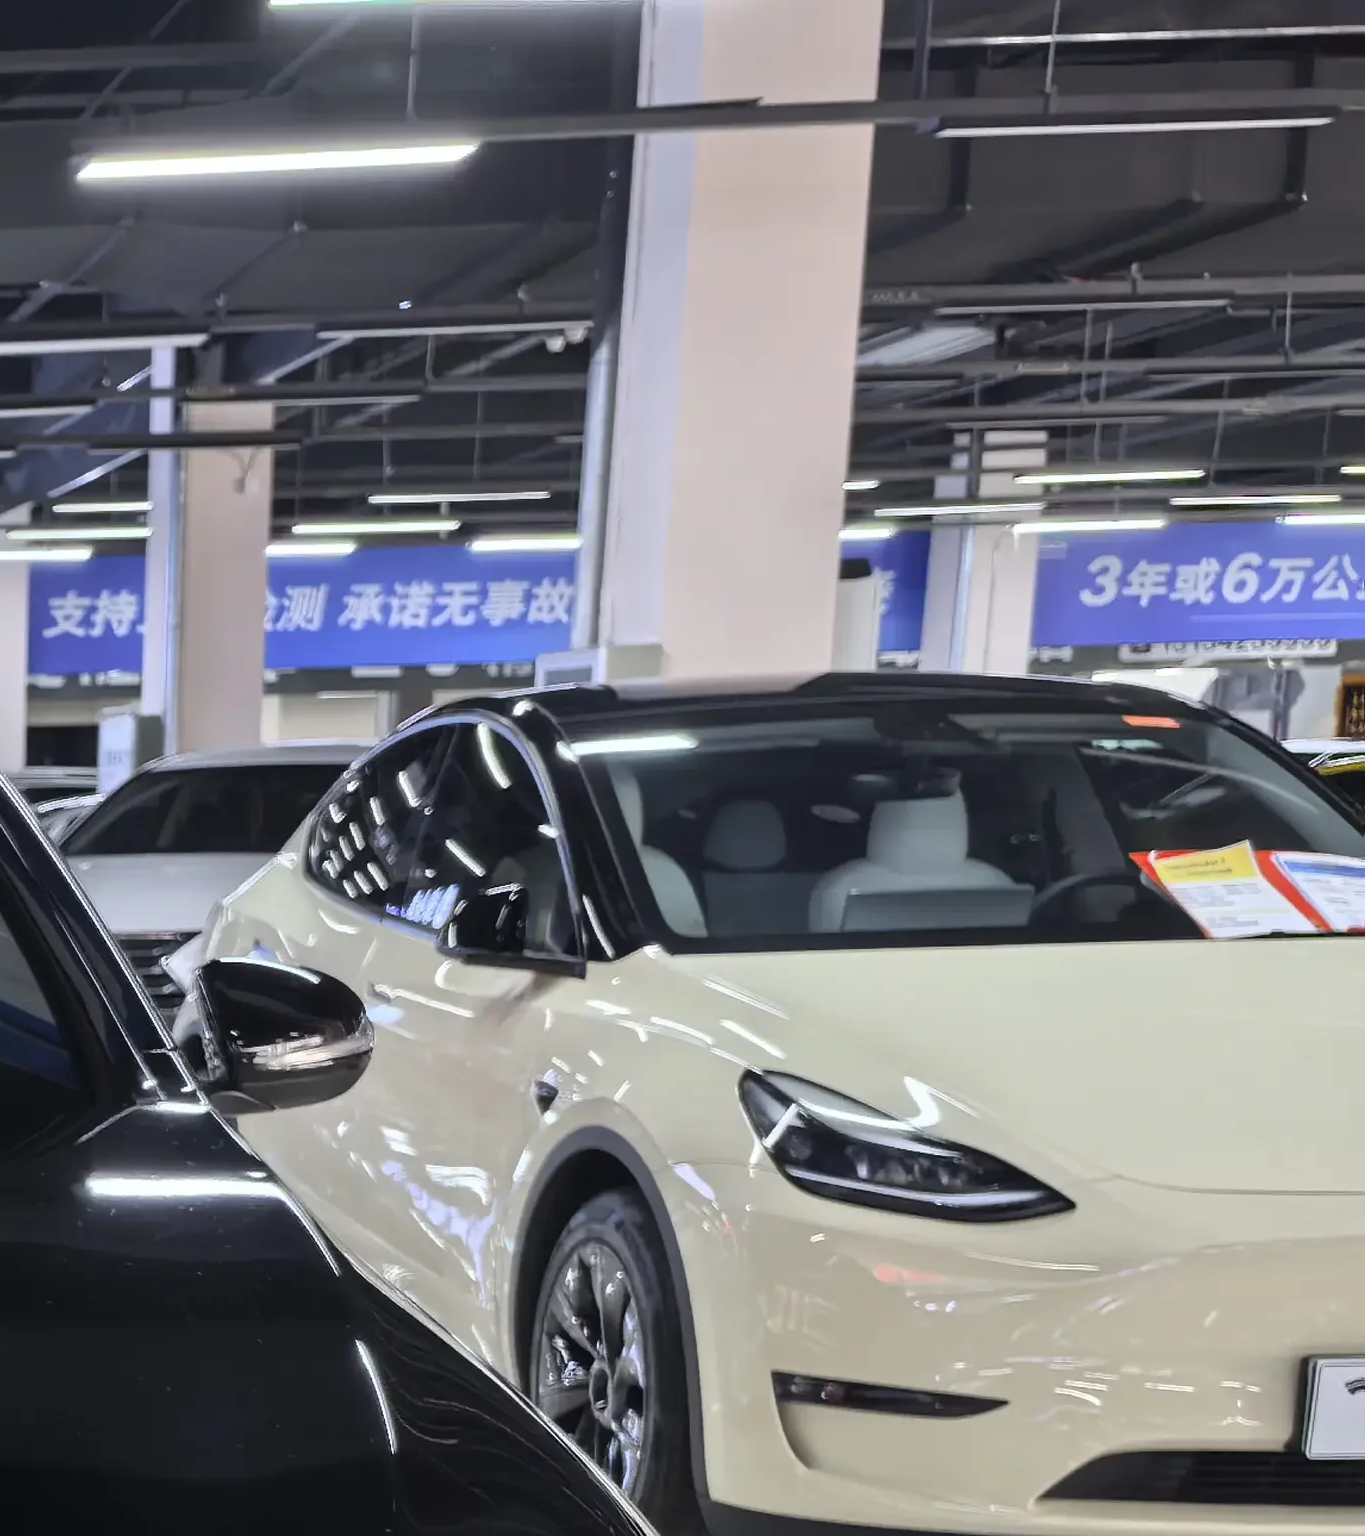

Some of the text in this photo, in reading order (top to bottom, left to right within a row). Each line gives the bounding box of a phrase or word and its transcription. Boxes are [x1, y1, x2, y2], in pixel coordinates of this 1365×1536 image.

[41, 588, 145, 639] 支持
[337, 576, 575, 631] 承诺无事故
[1078, 551, 1365, 609] 3年或6万公
